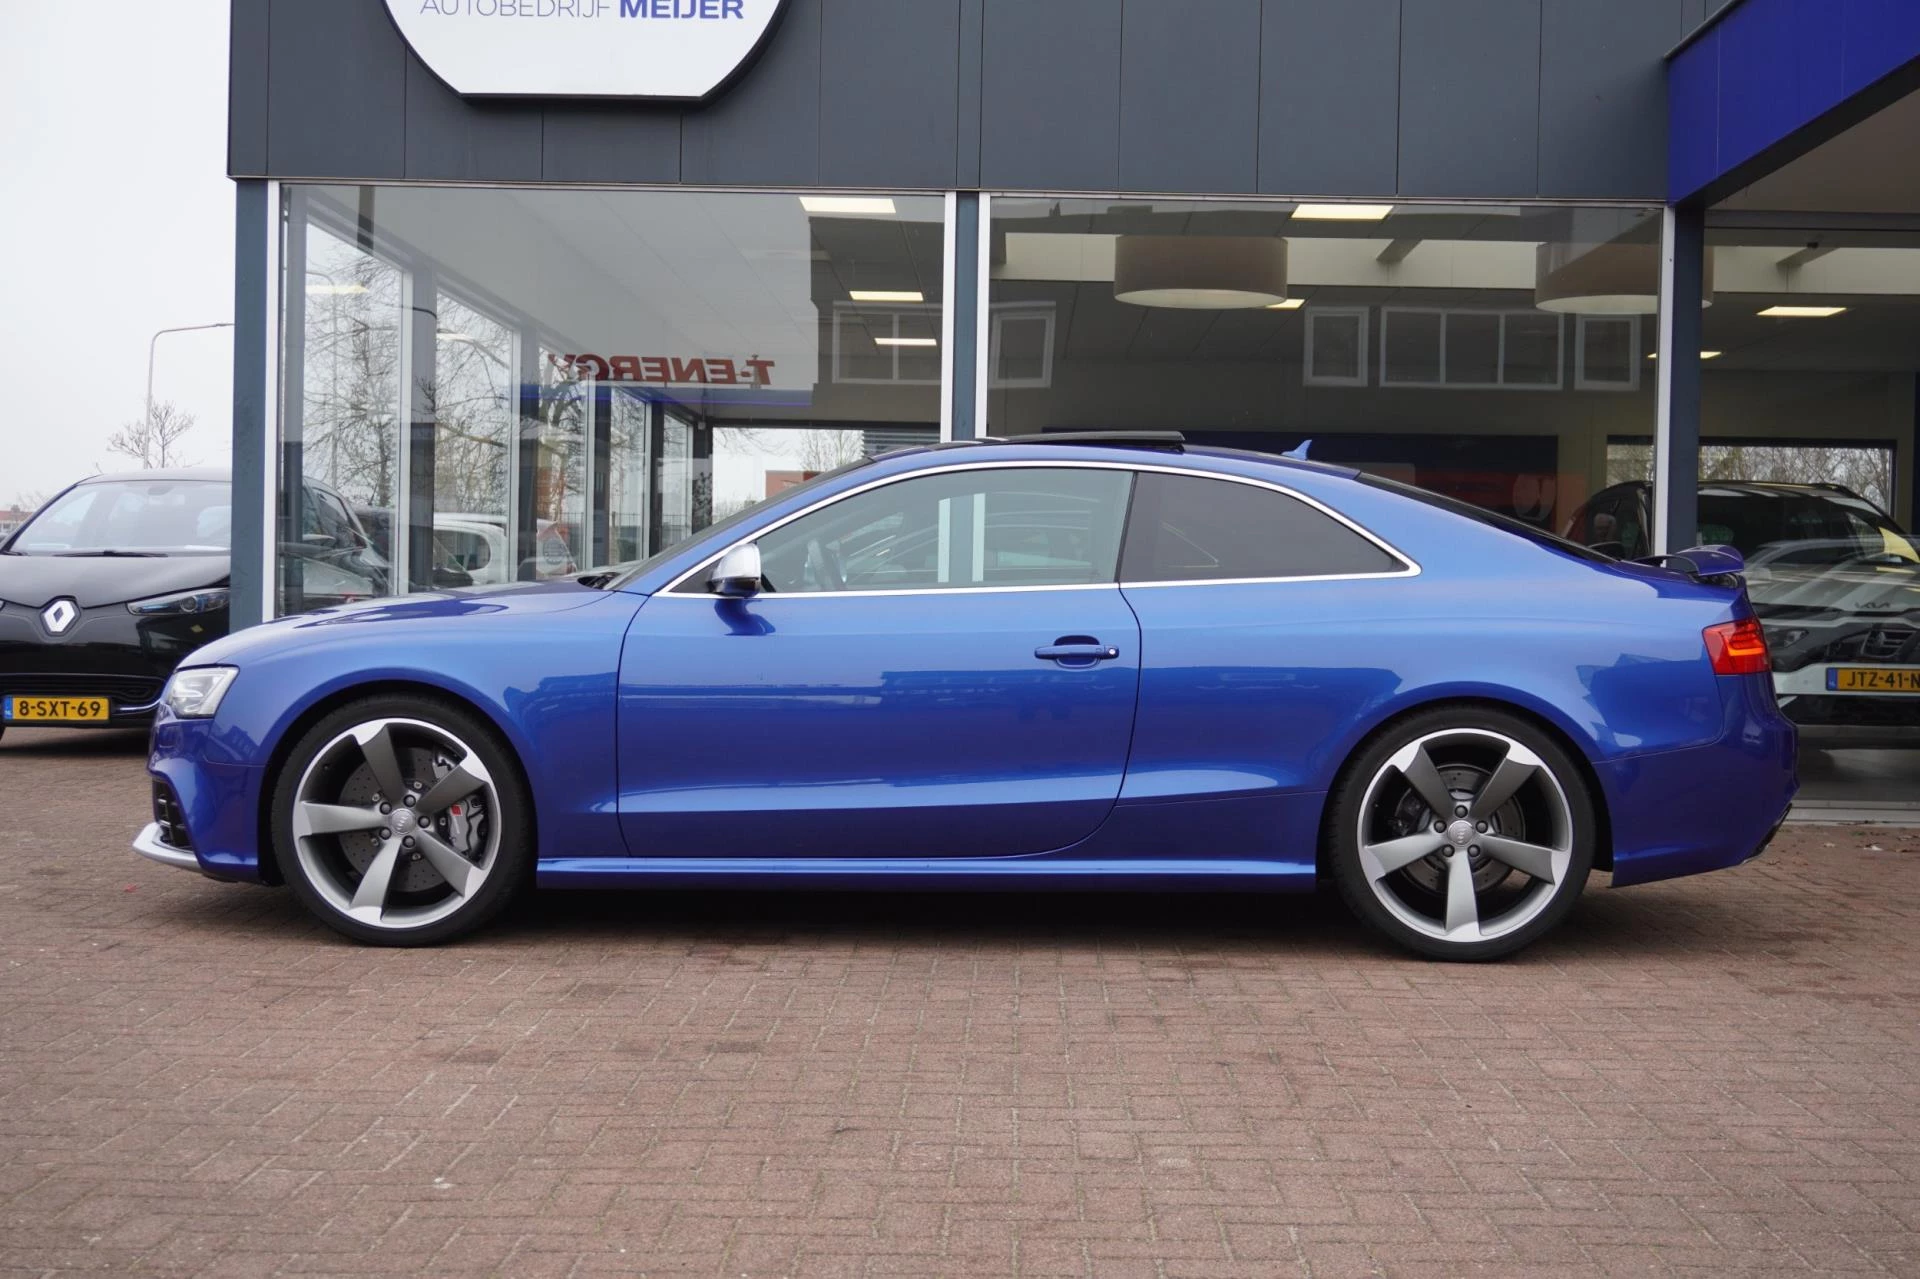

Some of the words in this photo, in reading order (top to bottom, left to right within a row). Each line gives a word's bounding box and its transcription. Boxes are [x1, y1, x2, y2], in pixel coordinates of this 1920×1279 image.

[420, 0, 610, 18] AUTOBEDRIJF
[620, 0, 744, 19] MEIJER
[1847, 671, 1920, 689] JTZ-41-N
[19, 700, 101, 717] 8-SXT-69
